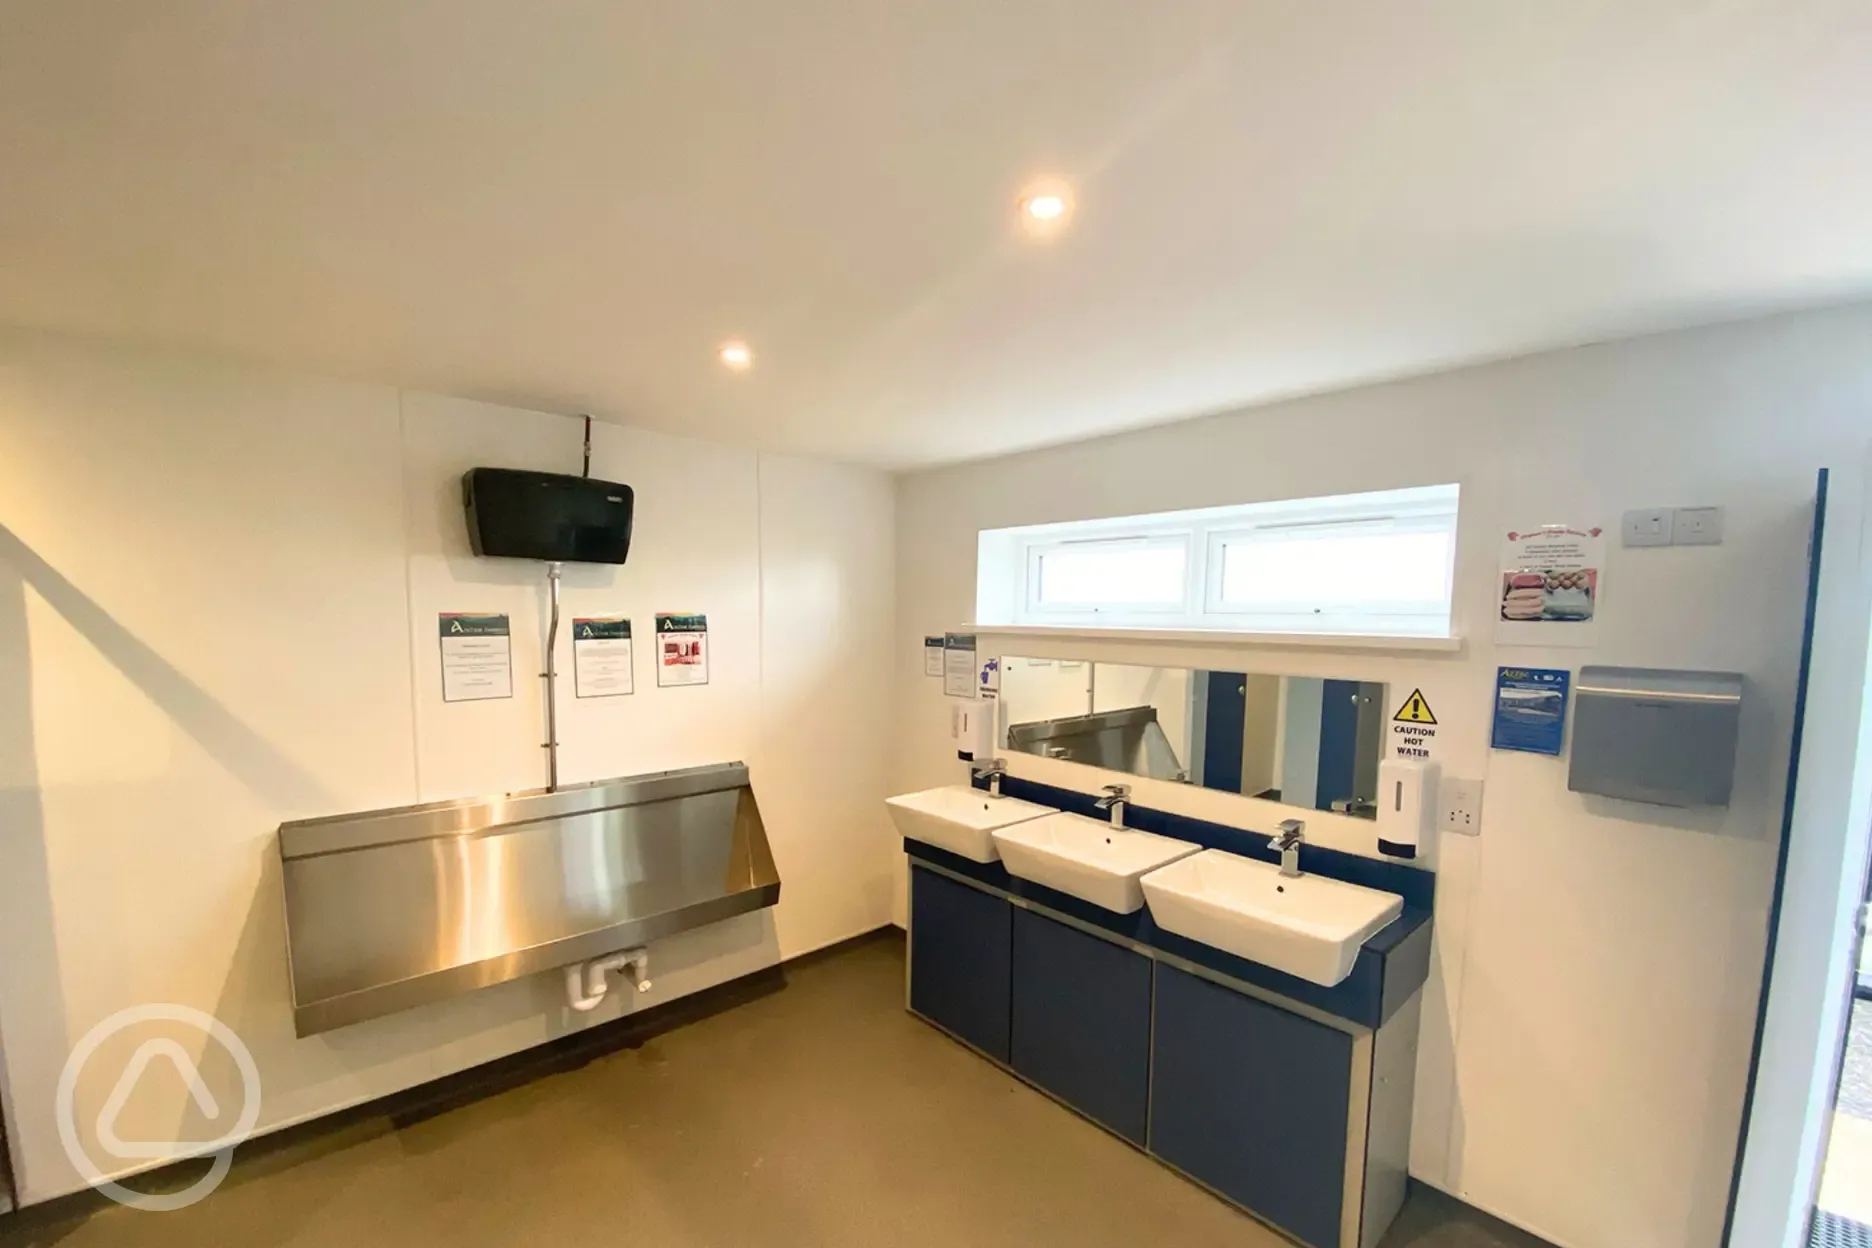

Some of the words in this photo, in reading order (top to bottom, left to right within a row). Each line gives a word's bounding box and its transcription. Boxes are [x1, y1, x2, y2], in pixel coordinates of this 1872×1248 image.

[1393, 725, 1436, 737] CAUTION
[1403, 737, 1424, 746] HOT
[1396, 746, 1430, 758] WATER
